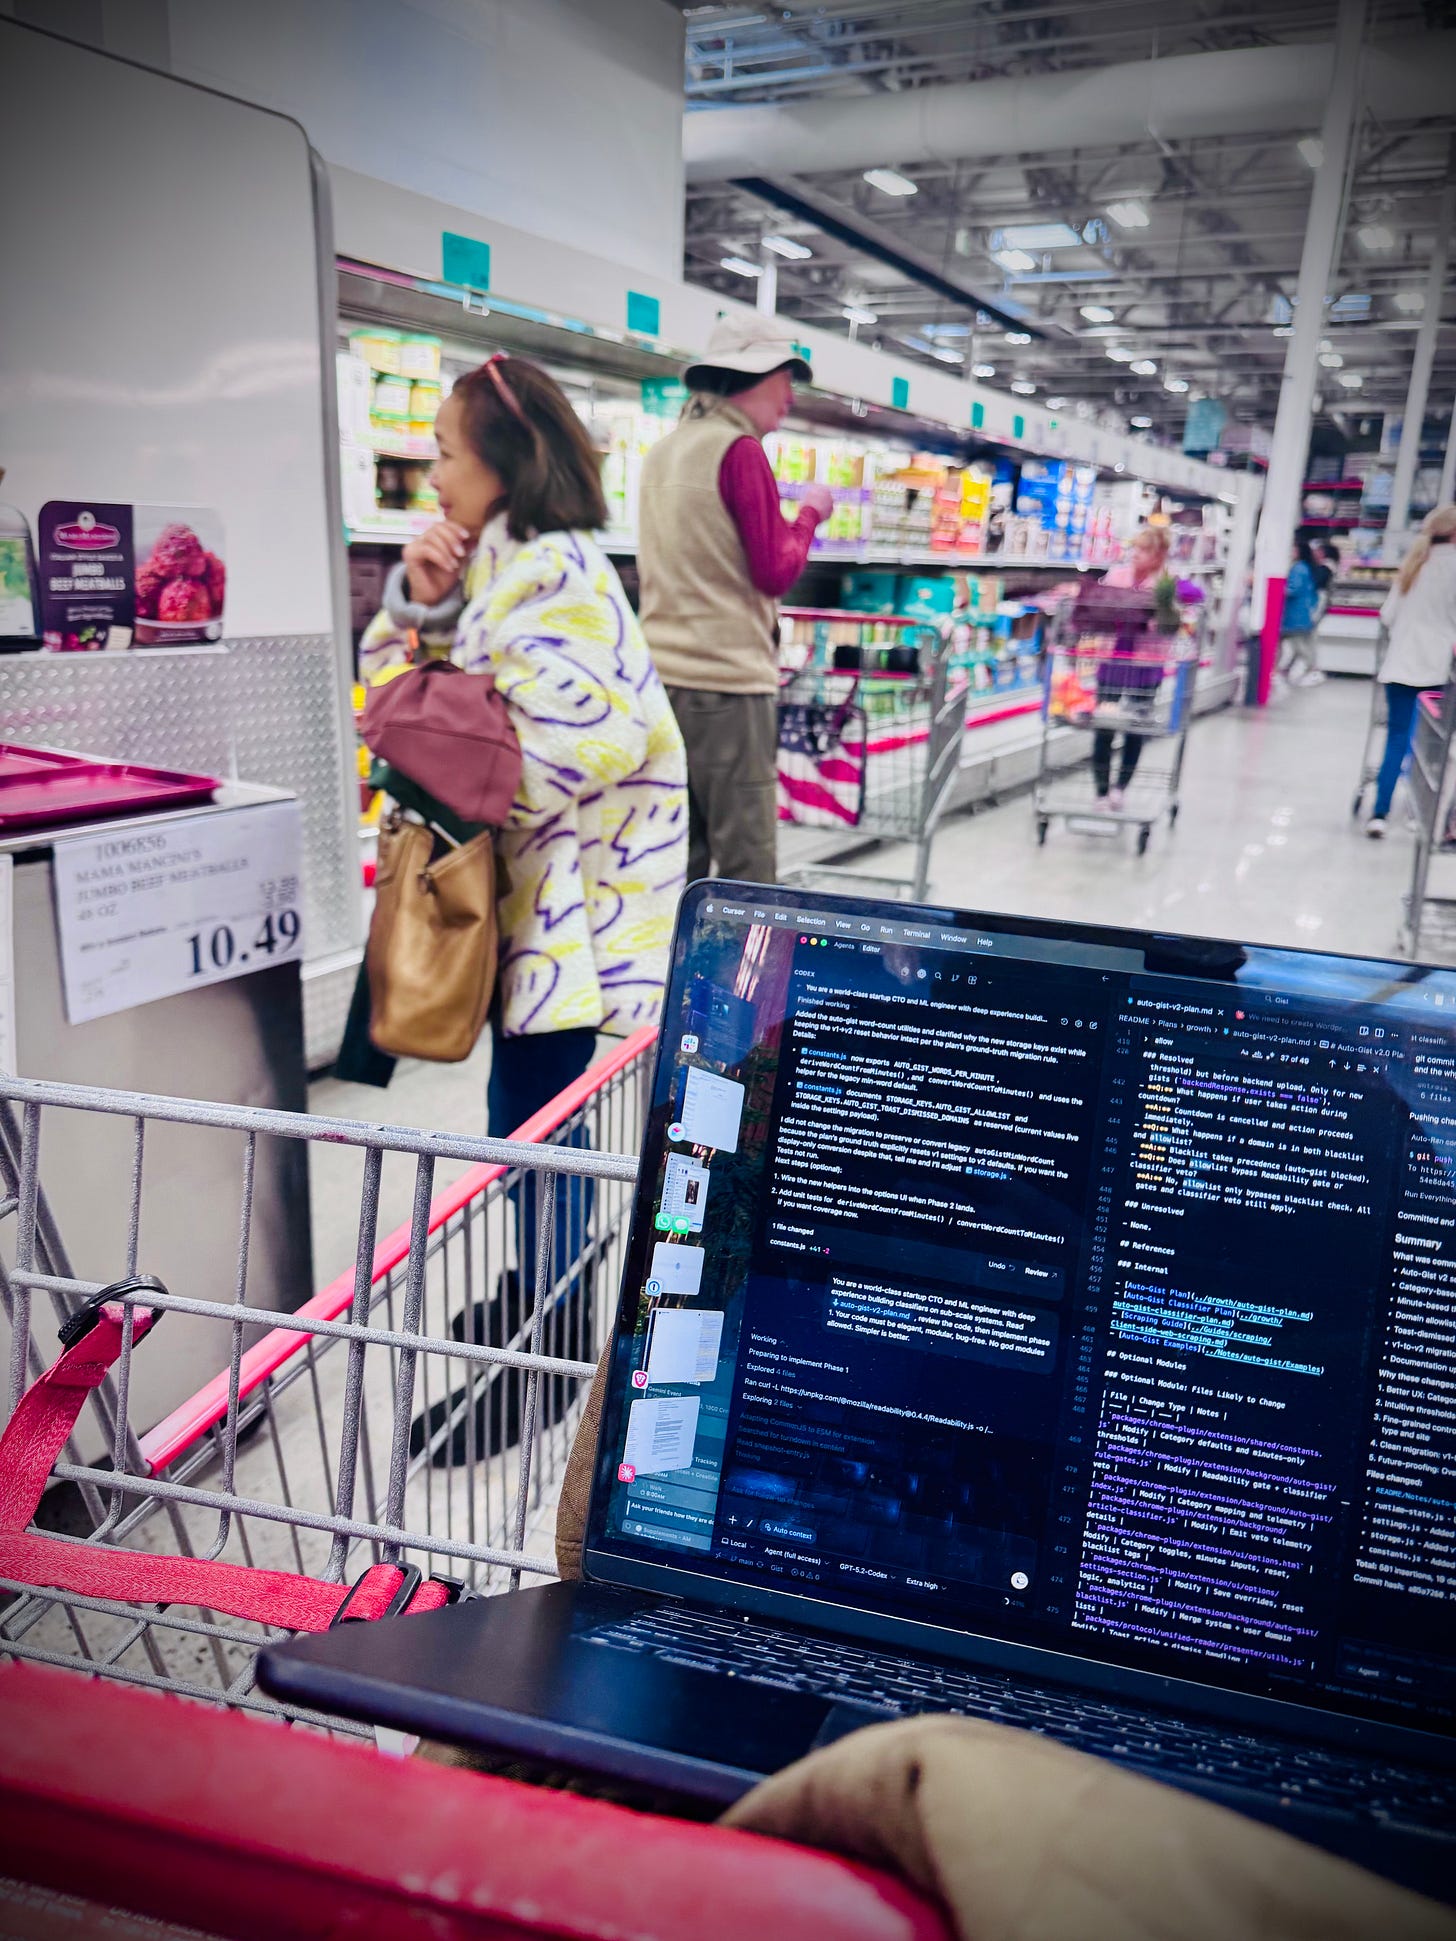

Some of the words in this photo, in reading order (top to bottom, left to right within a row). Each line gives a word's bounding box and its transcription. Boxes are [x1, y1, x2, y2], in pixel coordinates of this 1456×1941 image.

[722, 906, 745, 915] Cursor
[753, 910, 765, 918] File
[774, 912, 787, 920] Edit
[796, 915, 825, 925] Selection
[835, 920, 851, 928] View
[880, 925, 893, 934] Run
[903, 928, 930, 938] Terminal
[940, 933, 967, 943] Window
[976, 937, 993, 947] Help
[187, 909, 300, 975] 10.49
[833, 941, 854, 949] Agents
[862, 944, 880, 952] Editor
[793, 969, 815, 977] CODEX
[797, 995, 824, 1005] Finished
[824, 1000, 850, 1010] working
[1136, 999, 1213, 1014] auto-gist-v2-plan.md
[792, 1029, 816, 1039] Details:
[1154, 1036, 1173, 1045] allow
[1159, 1052, 1194, 1064] Resolved
[1415, 1054, 1425, 1062] git
[1426, 1056, 1455, 1066] commit
[1150, 1063, 1191, 1076] threshold)
[1195, 1069, 1208, 1078] but
[1212, 1072, 1239, 1082] before
[1242, 1076, 1273, 1087] backend
[1276, 1081, 1305, 1092] upload.
[1310, 1085, 1328, 1096] Only
[1332, 1088, 1345, 1097] for
[1137, 1092, 1180, 1104] countdown?
[1409, 1111, 1439, 1124] Pushing
[776, 1145, 793, 1154] Tests
[794, 1149, 805, 1157] not
[806, 1151, 818, 1159] run.
[774, 1156, 790, 1164] Next
[790, 1159, 808, 1168] steps
[809, 1161, 842, 1174] (optional):
[1129, 1160, 1172, 1172] classifier
[1175, 1168, 1197, 1177] veto?
[780, 1173, 796, 1182] Wire
[796, 1176, 807, 1184] the
[822, 1180, 847, 1191] helpers
[847, 1184, 861, 1193] into
[861, 1187, 873, 1195] the
[873, 1190, 898, 1199] options
[908, 1195, 926, 1204] when
[927, 1198, 948, 1208] Phase
[954, 1202, 975, 1212] lands.
[1141, 1202, 1184, 1216] Unresolved
[776, 1222, 786, 1230] file
[786, 1225, 814, 1235] changed
[769, 1238, 805, 1250] constants.js
[1132, 1241, 1174, 1255] References
[1394, 1232, 1442, 1250] Summary
[988, 1260, 1005, 1269] Undo
[1024, 1267, 1048, 1277] Review
[830, 1288, 866, 1300] experience
[867, 1294, 894, 1306] building
[894, 1300, 928, 1312] classifiers
[939, 1309, 973, 1320] sub-scale
[974, 1315, 1004, 1326] systems.
[1005, 1320, 1024, 1330] Read
[826, 1319, 853, 1330] allowed.
[854, 1324, 880, 1335] Simpler
[888, 1330, 910, 1341] better.
[750, 1332, 777, 1345] Working
[748, 1347, 779, 1360] Preparing
[788, 1355, 822, 1368] implement
[823, 1362, 844, 1372] Phase
[1118, 1351, 1152, 1364] Optional
[1155, 1358, 1186, 1370] Modules
[746, 1362, 774, 1373] Explored
[782, 1369, 795, 1377] files
[744, 1377, 757, 1386] Ran
[742, 1392, 772, 1405] Exploring
[779, 1400, 792, 1408] files
[1381, 1426, 1398, 1435] type
[1399, 1430, 1414, 1438] and
[1415, 1432, 1430, 1441] site
[695, 1456, 718, 1468] Tracking
[772, 1526, 788, 1534] Auto
[788, 1530, 812, 1540] context
[730, 1539, 746, 1548] Local
[764, 1547, 782, 1556] Agent
[783, 1551, 796, 1559] (full
[796, 1554, 821, 1565] access)
[839, 1563, 887, 1578] GPT-5.2-Codex
[906, 1577, 923, 1586] Extra
[923, 1581, 938, 1590] high
